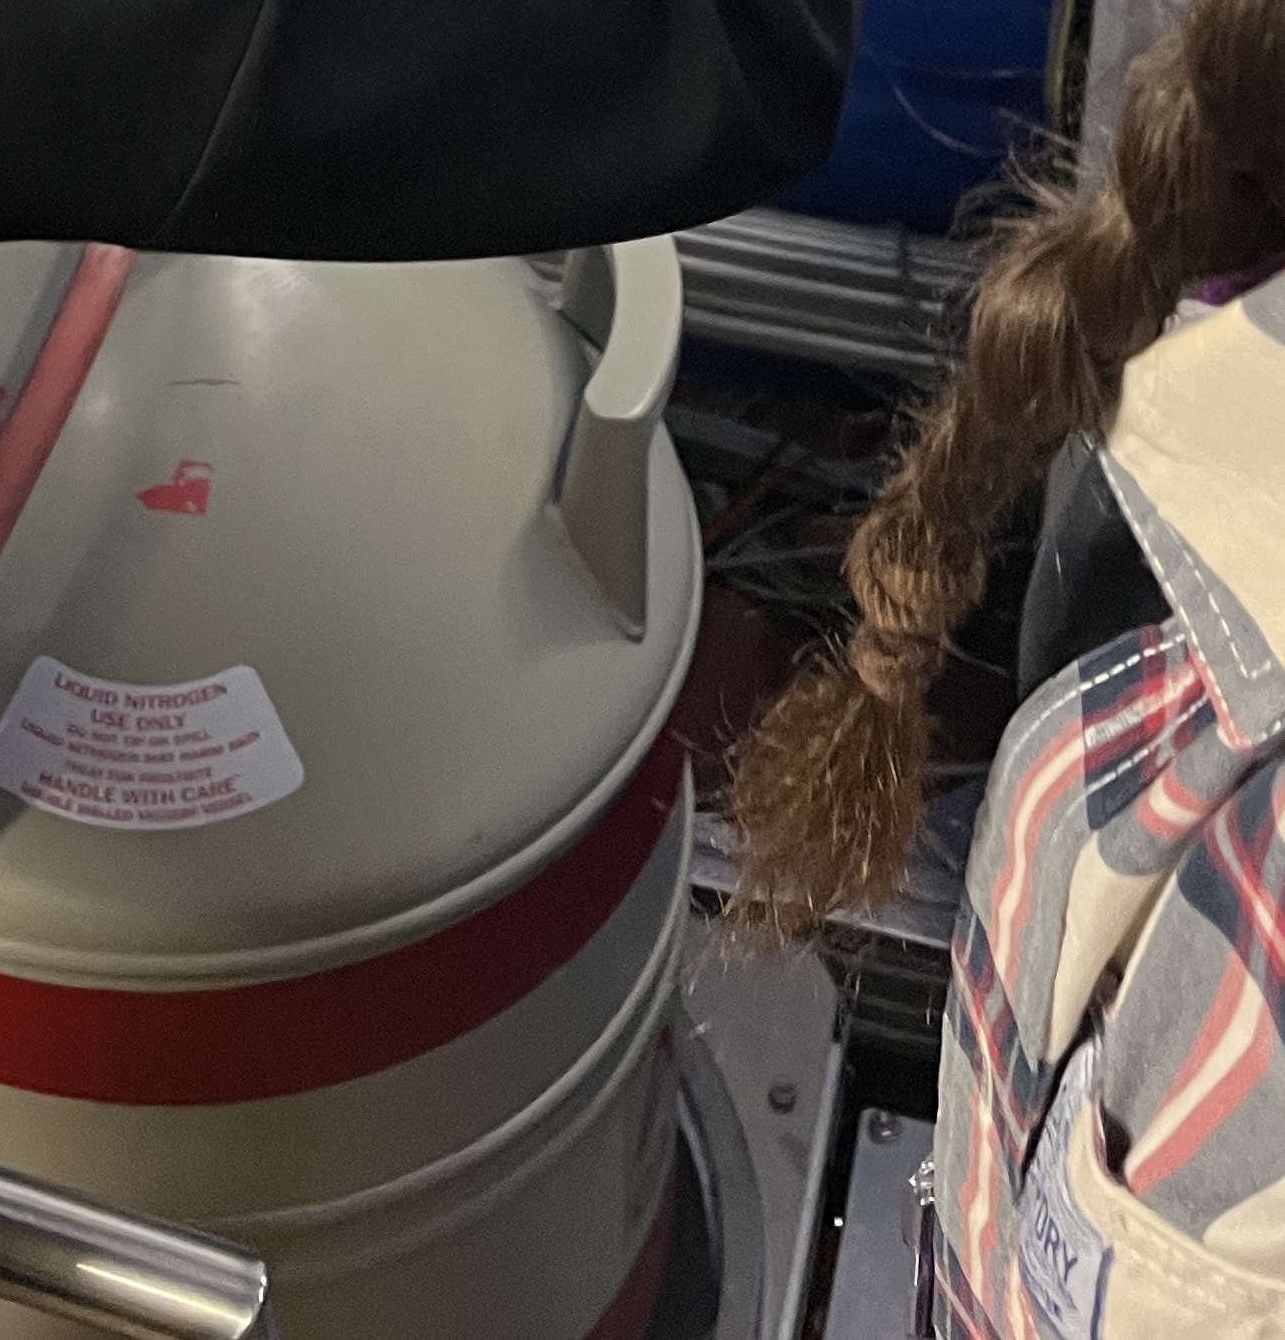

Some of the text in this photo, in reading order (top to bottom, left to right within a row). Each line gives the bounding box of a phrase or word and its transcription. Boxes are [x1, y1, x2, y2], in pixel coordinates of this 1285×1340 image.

[53, 671, 228, 710] LIQUID NITROGEN
[90, 708, 188, 731] USE ONLY
[38, 771, 118, 804] HANDLE
[122, 787, 176, 805] WITH
[181, 775, 240, 802] CARE
